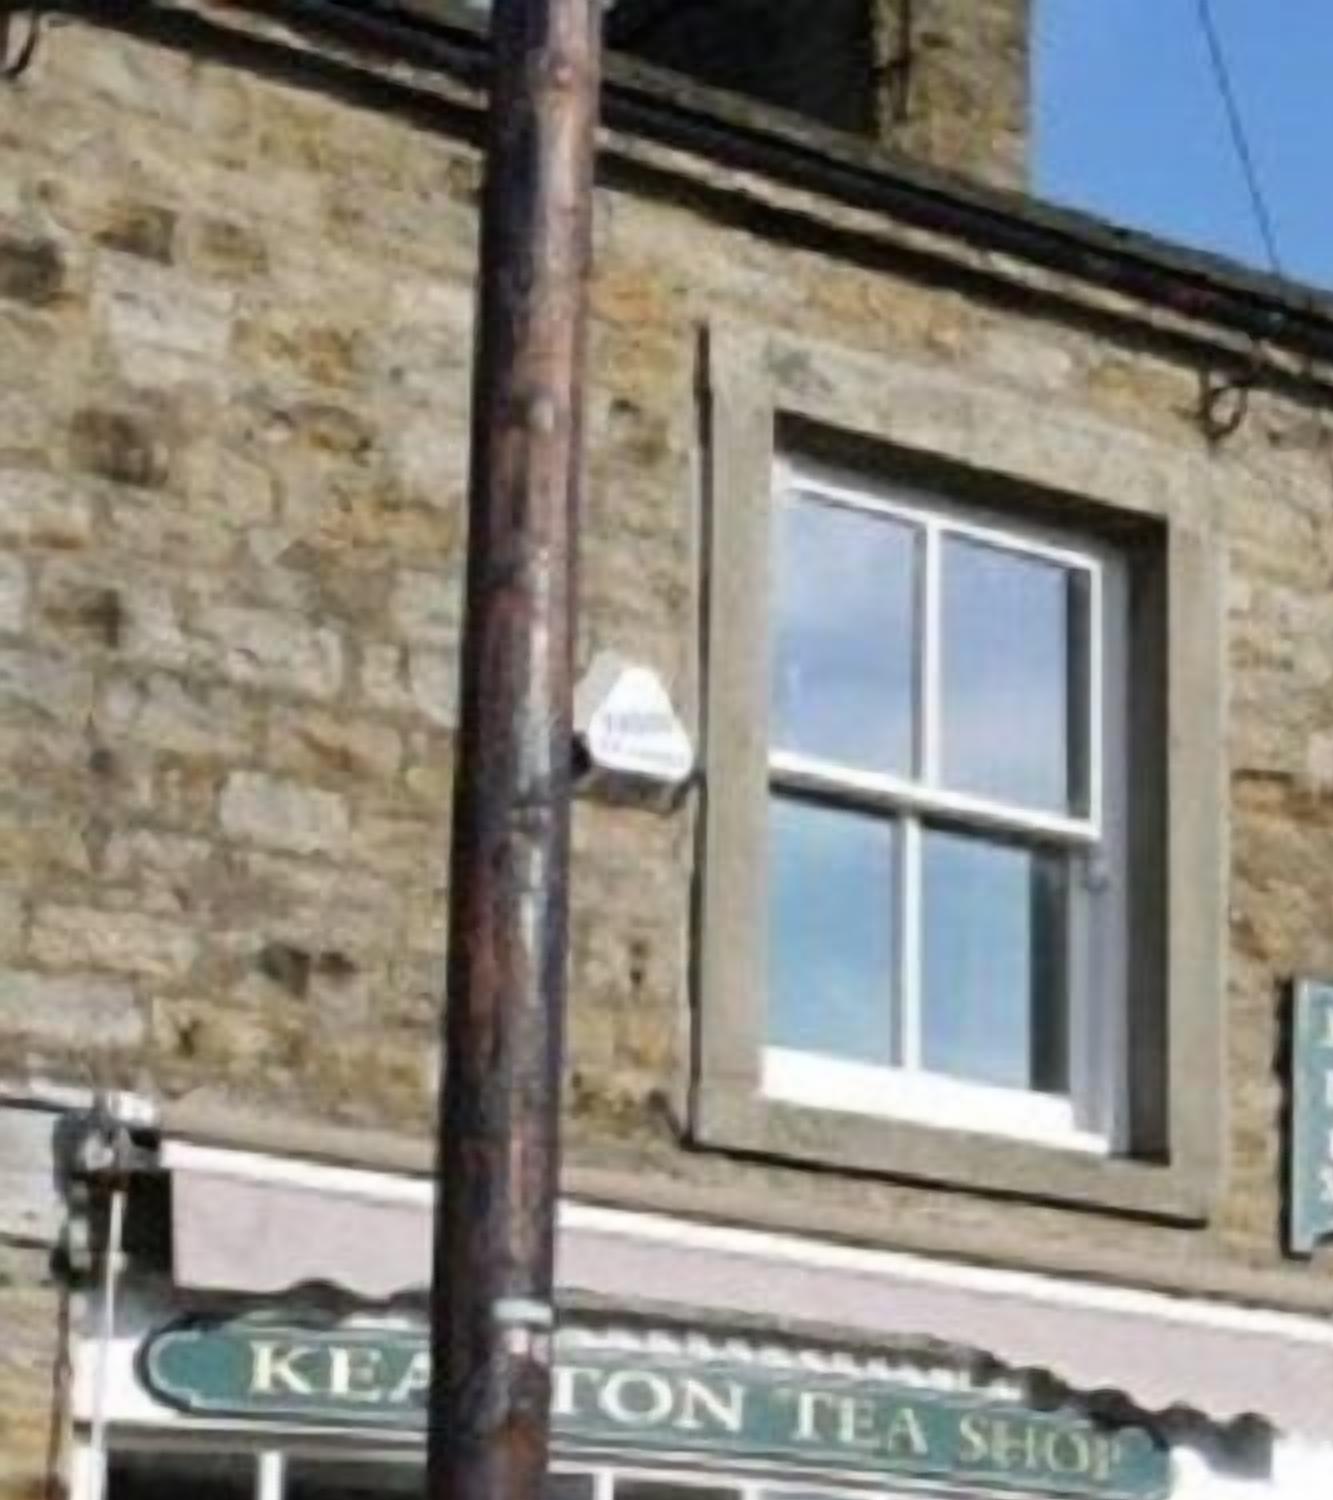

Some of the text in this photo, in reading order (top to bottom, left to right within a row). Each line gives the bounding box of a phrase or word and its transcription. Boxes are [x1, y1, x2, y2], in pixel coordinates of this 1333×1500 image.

[249, 1338, 1123, 1482] KEATON TEA SHOP
